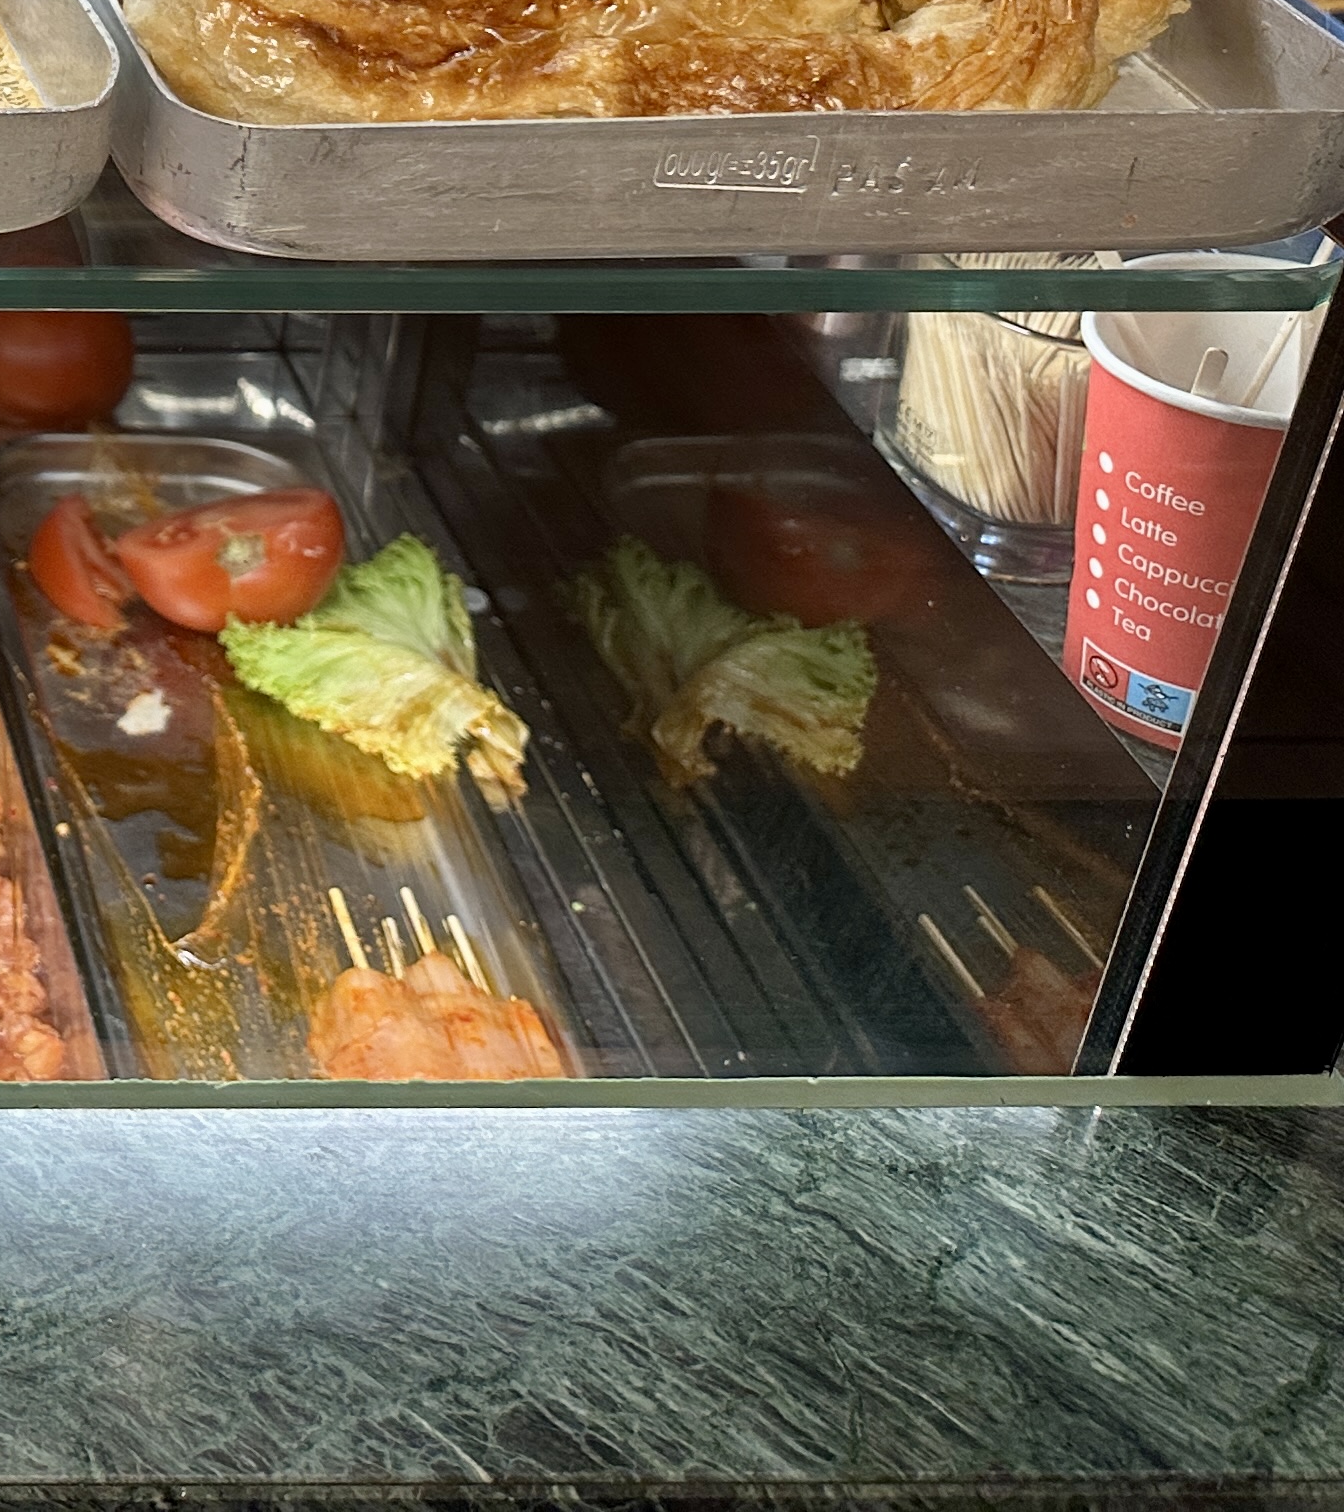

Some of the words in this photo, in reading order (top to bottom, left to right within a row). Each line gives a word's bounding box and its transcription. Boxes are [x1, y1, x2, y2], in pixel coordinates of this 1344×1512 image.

[1125, 471, 1206, 516] Coffee
[1121, 506, 1178, 547] Latte
[1112, 606, 1152, 641] Tea
